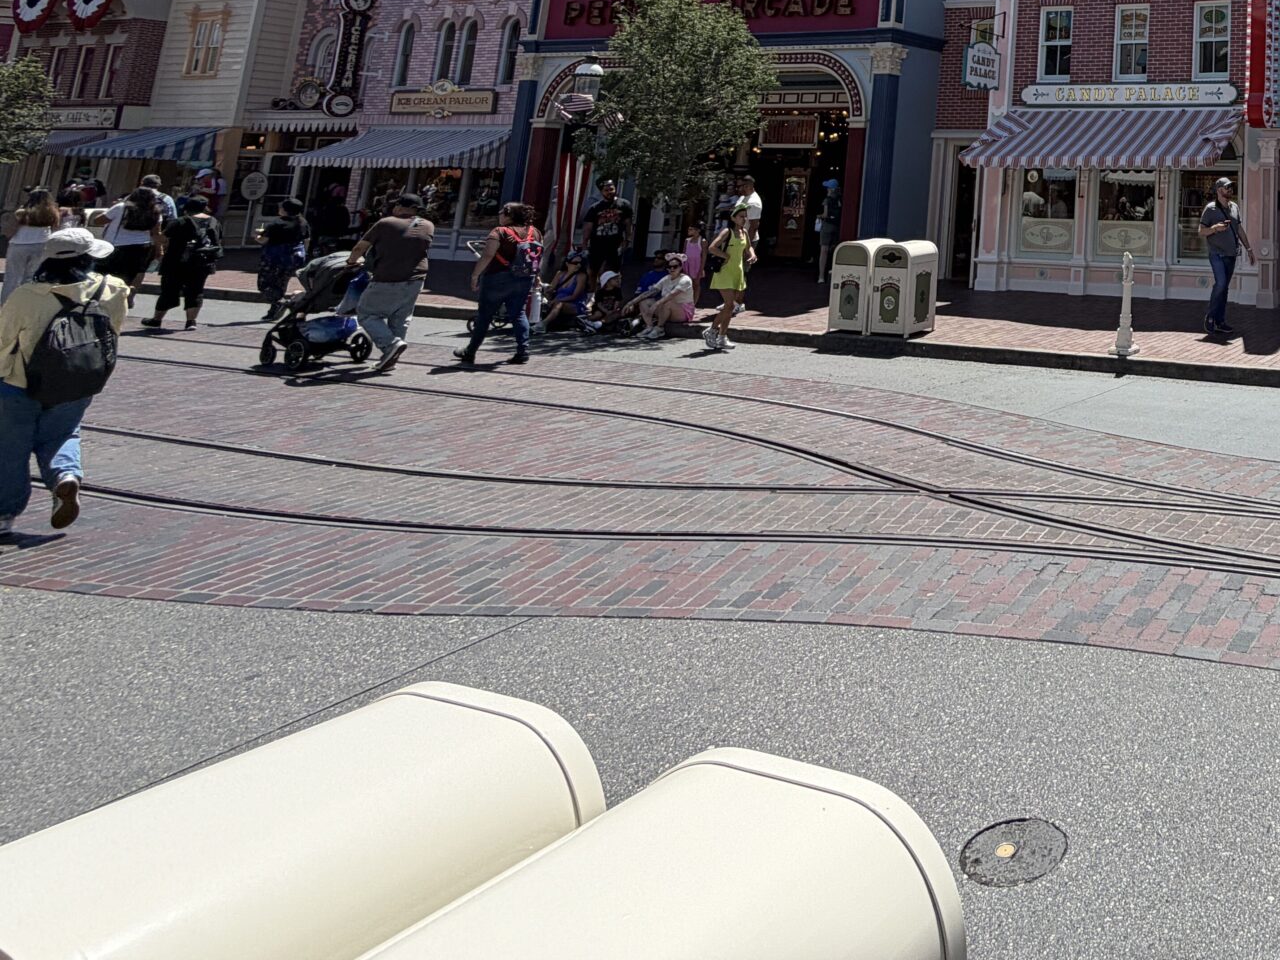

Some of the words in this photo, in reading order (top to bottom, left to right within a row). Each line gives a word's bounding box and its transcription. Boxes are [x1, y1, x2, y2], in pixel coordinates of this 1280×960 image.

[351, 15, 362, 44] ICE
[341, 44, 360, 88] CREAM
[972, 54, 995, 68] CANDY
[970, 66, 996, 80] PALACE
[1055, 87, 1119, 101] CANDY
[1125, 86, 1200, 101] PALACE
[397, 97, 411, 106] ICE
[413, 97, 447, 105] CREAM
[449, 96, 489, 105] PARLOR
